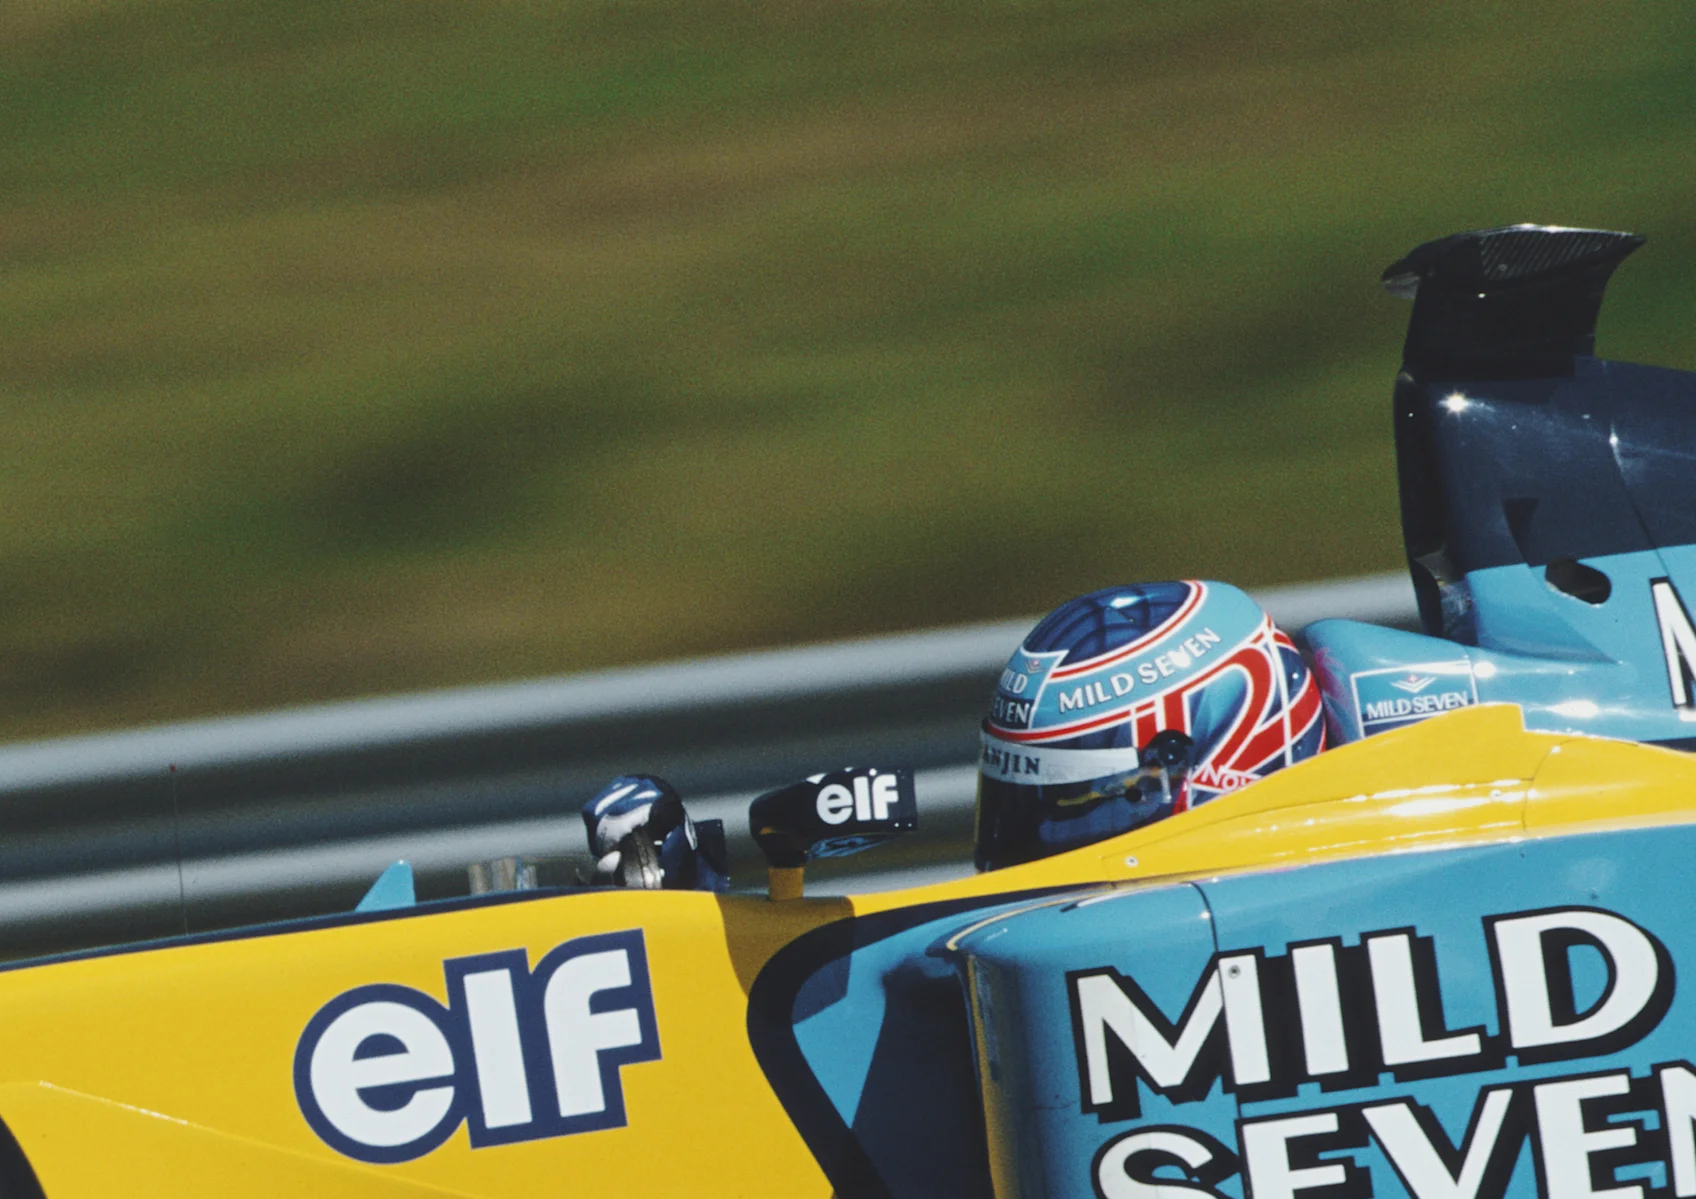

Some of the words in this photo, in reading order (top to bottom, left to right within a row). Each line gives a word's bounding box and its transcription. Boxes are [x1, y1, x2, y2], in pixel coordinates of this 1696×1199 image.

[1058, 672, 1135, 713] MILD
[1141, 627, 1222, 684] SEVEN
[1365, 697, 1412, 720] MILD
[1412, 690, 1468, 714] SEVEN
[815, 773, 899, 825] elf
[309, 948, 644, 1148] elf
[1076, 910, 1659, 1105] MILD
